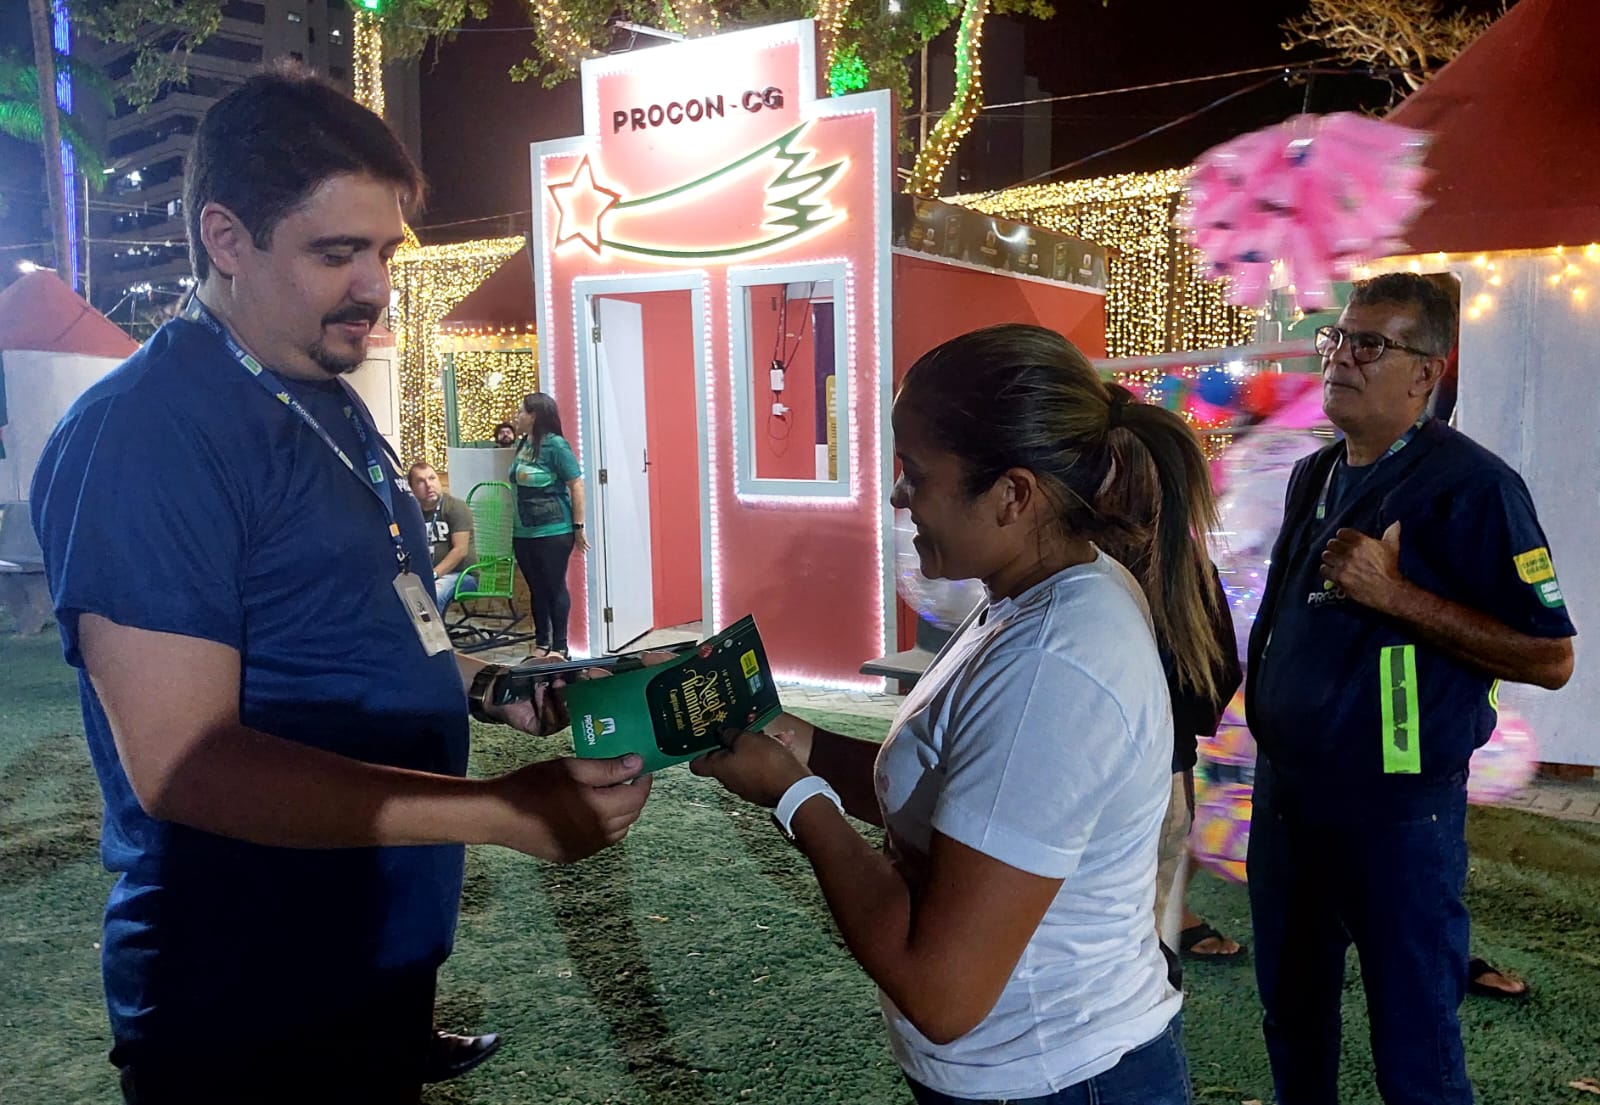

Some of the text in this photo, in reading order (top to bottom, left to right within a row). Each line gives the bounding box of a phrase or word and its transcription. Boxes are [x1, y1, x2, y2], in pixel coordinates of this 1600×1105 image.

[291, 400, 319, 430] PROCON
[1307, 590, 1346, 604] PROCO
[681, 669, 708, 737] Iluminado
[699, 670, 726, 714] Natal
[583, 714, 597, 746] PROCON
